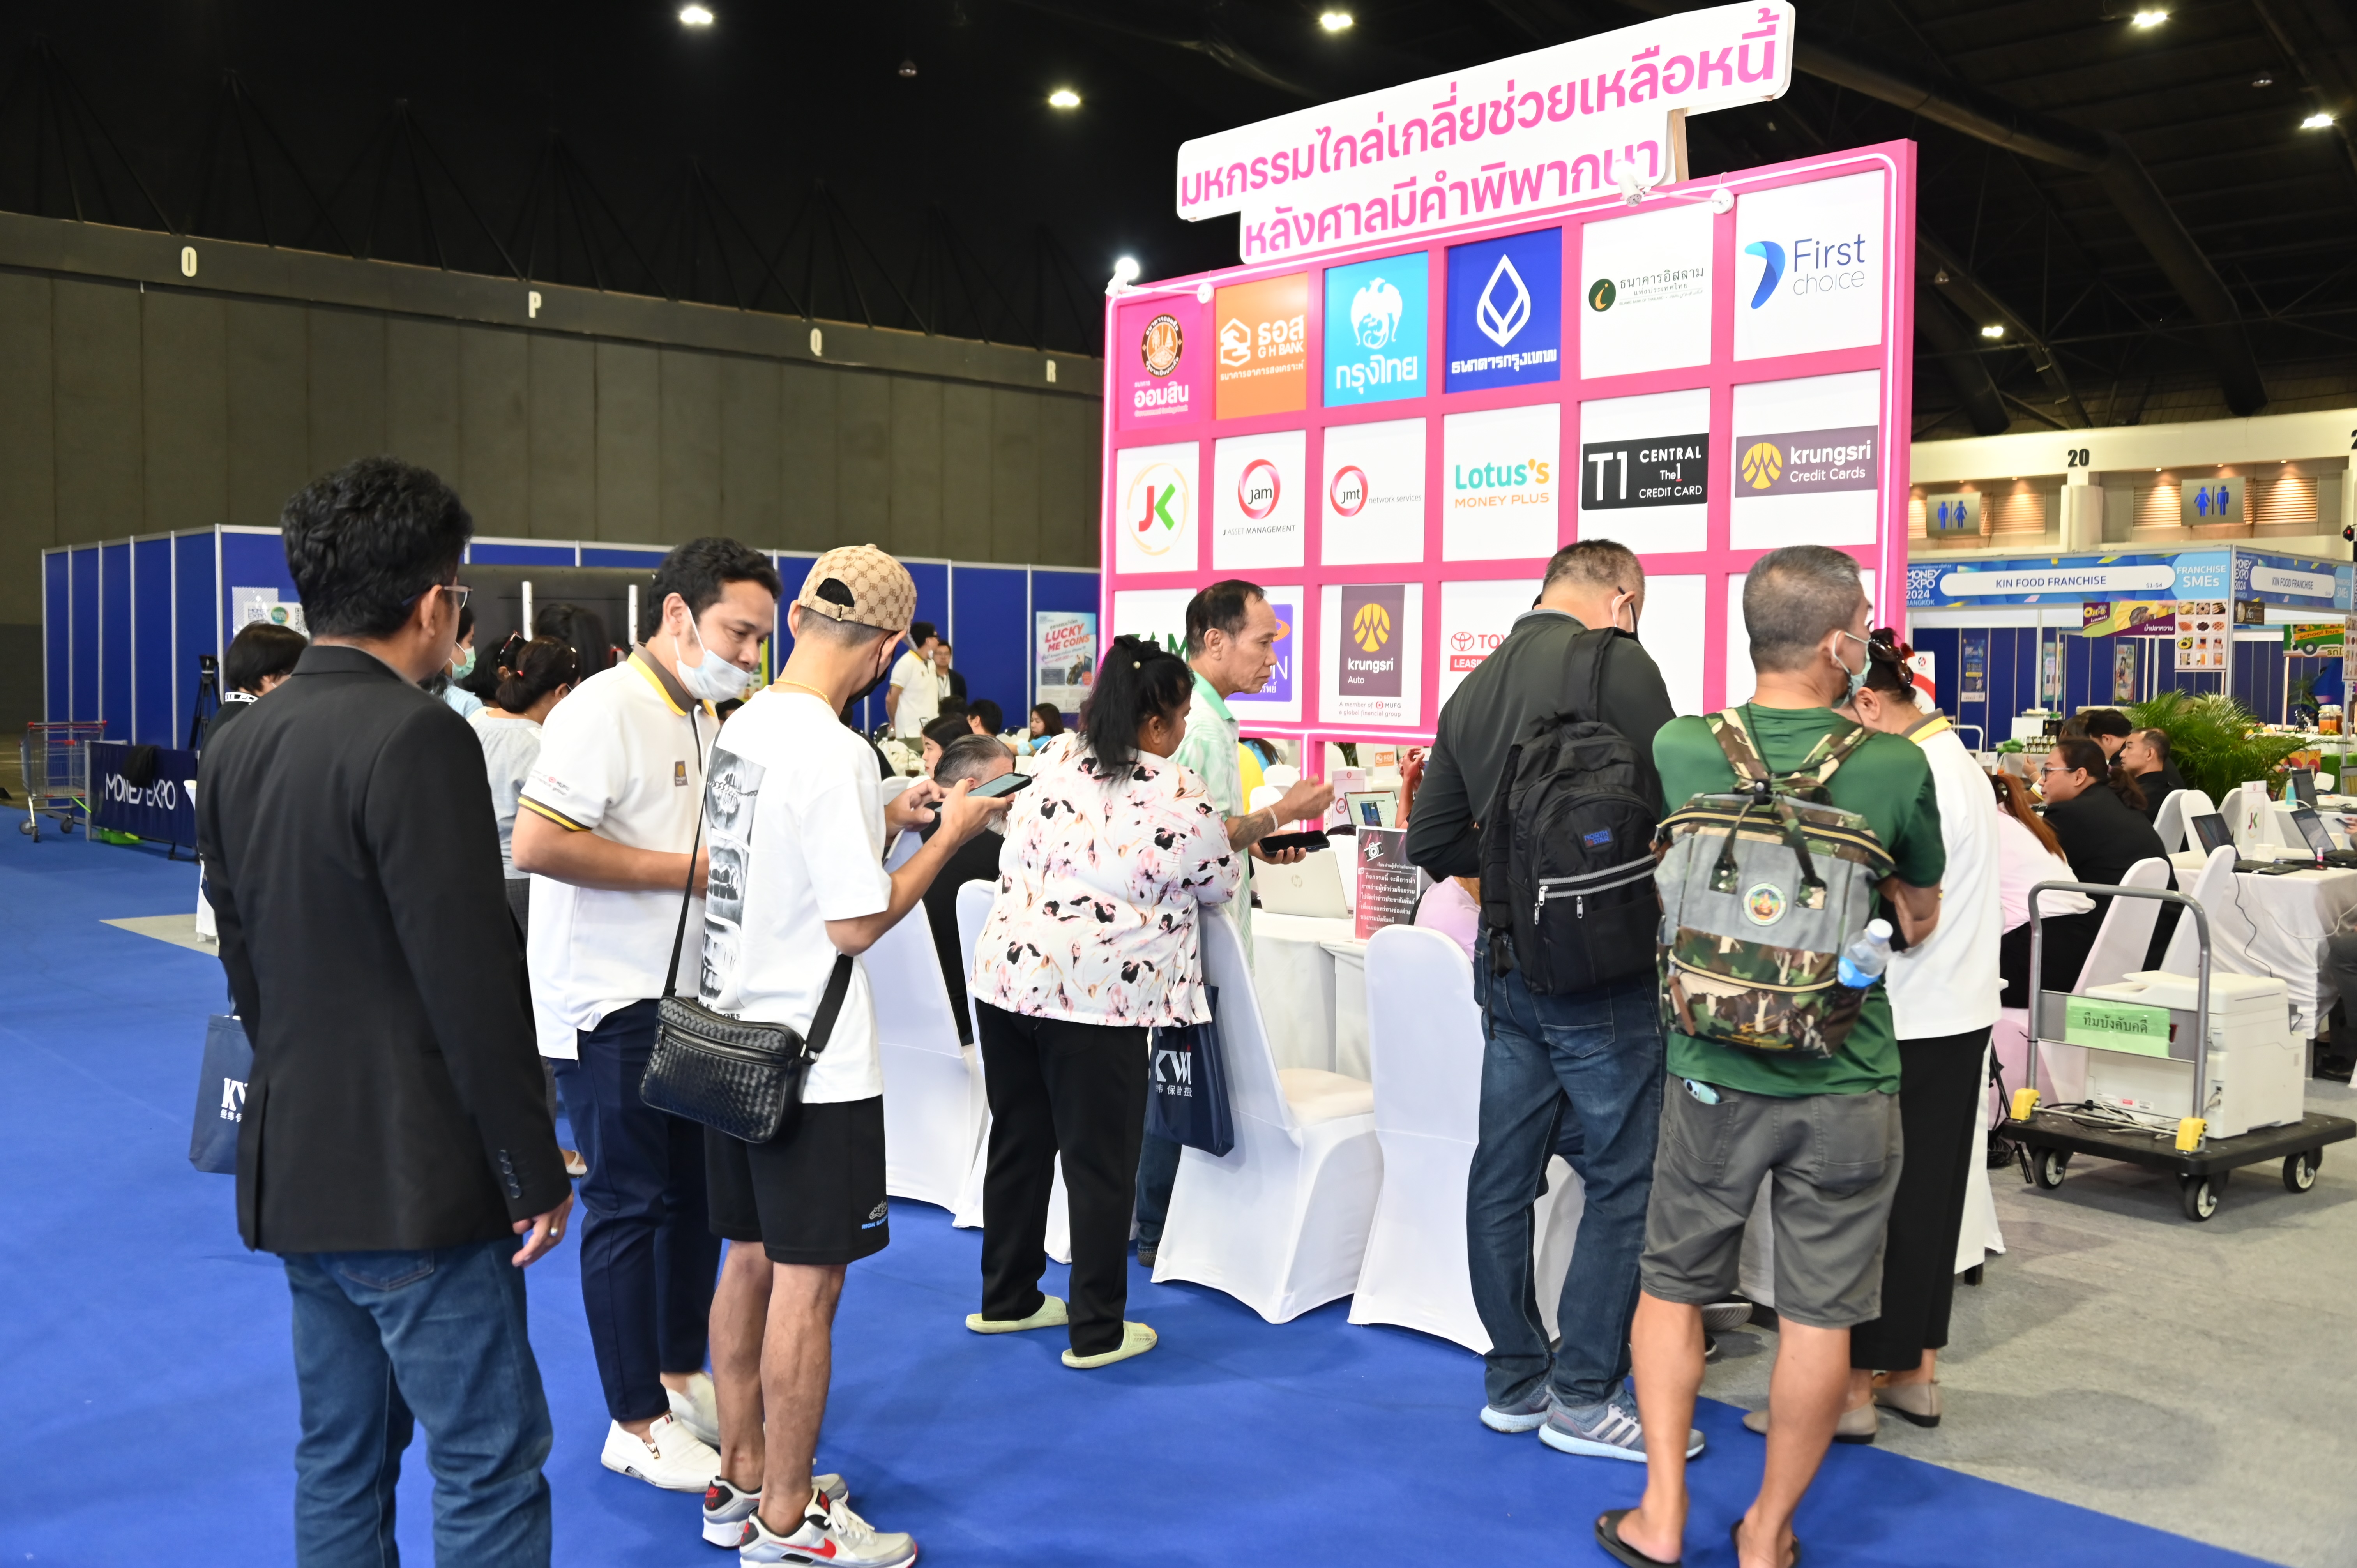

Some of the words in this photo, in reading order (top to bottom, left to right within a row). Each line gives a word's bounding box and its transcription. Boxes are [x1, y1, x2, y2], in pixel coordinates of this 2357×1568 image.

[1180, 7, 1781, 207] มหกรรมไกล่เกลี่ยช่วยเหลือหนี้
[181, 246, 197, 277] O
[1795, 234, 1865, 272] First
[1620, 268, 1703, 289] ธนาคารอิสลาม
[1793, 271, 1864, 295] choice
[1634, 283, 1688, 295] แห่งประเทศไทย
[528, 291, 541, 318] P
[1258, 315, 1304, 346] ธอส
[810, 328, 822, 356] Q
[1279, 341, 1303, 355] BANK
[1452, 349, 1557, 371] ธนาคารกรุงเทพ
[1046, 360, 1056, 383] R
[1220, 360, 1304, 381] ธนาคารอาคารสงเคราะห์
[1336, 355, 1417, 394] กรุงไทย
[1134, 381, 1189, 408] ออมสิน
[1640, 446, 1702, 463] CENTRAL
[1790, 440, 1871, 466] krungsri
[2068, 449, 2090, 467] 20
[1455, 459, 1550, 490] Lotus's
[1588, 451, 1628, 501] T1
[1790, 469, 1826, 483] Credit
[1830, 466, 1866, 480] Cards
[1248, 487, 1272, 505] jam
[1341, 489, 1360, 504] jmt
[1368, 495, 1395, 504] network
[1396, 493, 1422, 503] services
[1455, 495, 1507, 508] MONEY
[1512, 493, 1550, 505] PLUS
[1639, 487, 1671, 499] CREDIT
[1674, 485, 1703, 497] CARD
[1138, 483, 1175, 532] JK
[1246, 524, 1296, 535] MANAGEMENT
[2177, 565, 2226, 574] FRANCHISE
[2236, 559, 2252, 569] MONEY
[1907, 569, 1942, 579] MONEY
[1996, 579, 2012, 588] KIN
[2016, 578, 2044, 588] FOOD
[2048, 576, 2106, 586] FRANCHISE
[2183, 576, 2219, 588] SMEs
[2235, 569, 2249, 580] EXPO
[1906, 579, 1936, 589] EXPO
[2235, 581, 2246, 591] 2024
[2280, 578, 2291, 588] FOOD
[2292, 579, 2313, 590] FRANCHISE
[1906, 590, 1930, 599] 2024
[1044, 623, 1085, 643] LUCKY
[2299, 630, 2323, 639] school
[1048, 642, 1061, 653] ME
[1063, 634, 1090, 648] COINS
[1348, 657, 1394, 674] krungsri
[1348, 675, 1365, 684] Auto
[1584, 830, 1608, 841] NORTH
[1594, 836, 1610, 844] STAR
[1366, 872, 1389, 881] กิจกรรมนี้
[1390, 876, 1415, 884] จะมีการนำ
[1361, 883, 1415, 895] ภาพถ่ายผู้เข้าร่วมกิจกรรม
[1360, 892, 1415, 905] ไปจัดทำข่าวประชาสัมพันธ์
[1360, 914, 1395, 923] ของกรมบังคับคดี
[2083, 1012, 2148, 1033] ทีมบังคับคดี
